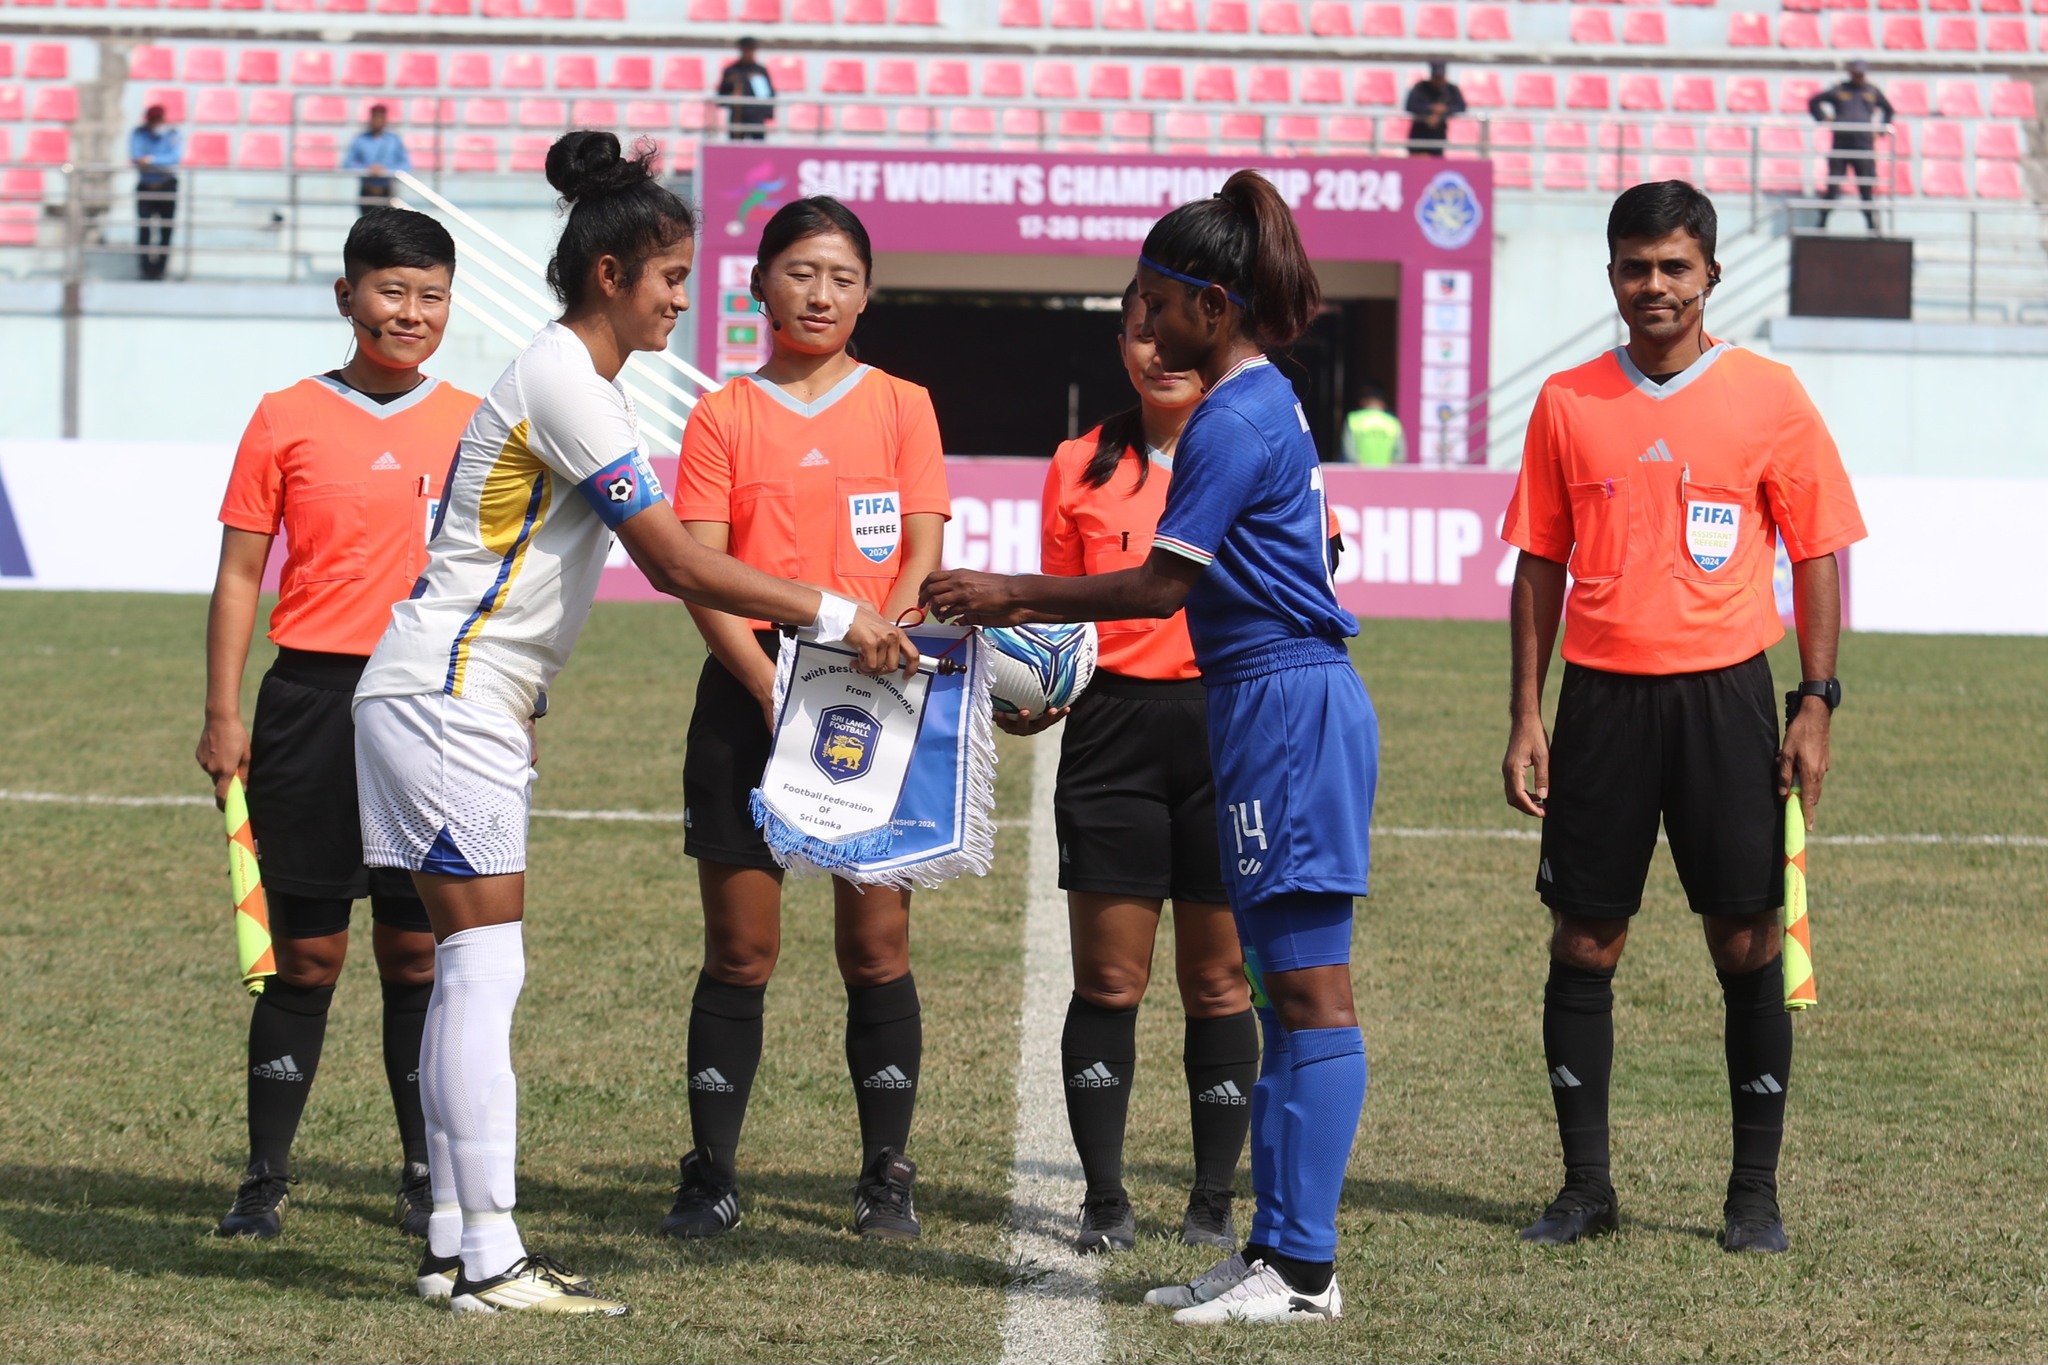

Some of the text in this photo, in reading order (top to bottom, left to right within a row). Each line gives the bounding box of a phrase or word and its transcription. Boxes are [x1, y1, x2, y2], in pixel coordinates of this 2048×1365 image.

[798, 159, 880, 200] SAFF
[883, 162, 1046, 206] WOMEN'S
[1312, 168, 1404, 212] 2024
[853, 497, 896, 516] FIFA
[1691, 506, 1734, 525] FIFA
[856, 524, 897, 536] REFEREE
[1691, 530, 1732, 540] ASSISTANT
[1694, 539, 1729, 548] REFEREE
[868, 548, 889, 557] 2024
[1700, 556, 1720, 566] 2024
[801, 666, 827, 682] With
[829, 665, 853, 674] Best
[845, 685, 872, 698] From
[829, 720, 869, 738] FOOTBALL
[830, 714, 871, 731] SRI LANKA
[783, 783, 873, 814] Football Federation
[799, 812, 842, 831] Sri Lanka
[918, 820, 936, 828] 2024
[1228, 799, 1268, 854] 14
[252, 1066, 304, 1082] adidas
[689, 1079, 735, 1093] adidas
[863, 1078, 913, 1090] adidas
[1068, 1076, 1120, 1088] adidas
[1198, 1092, 1248, 1105] adidas
